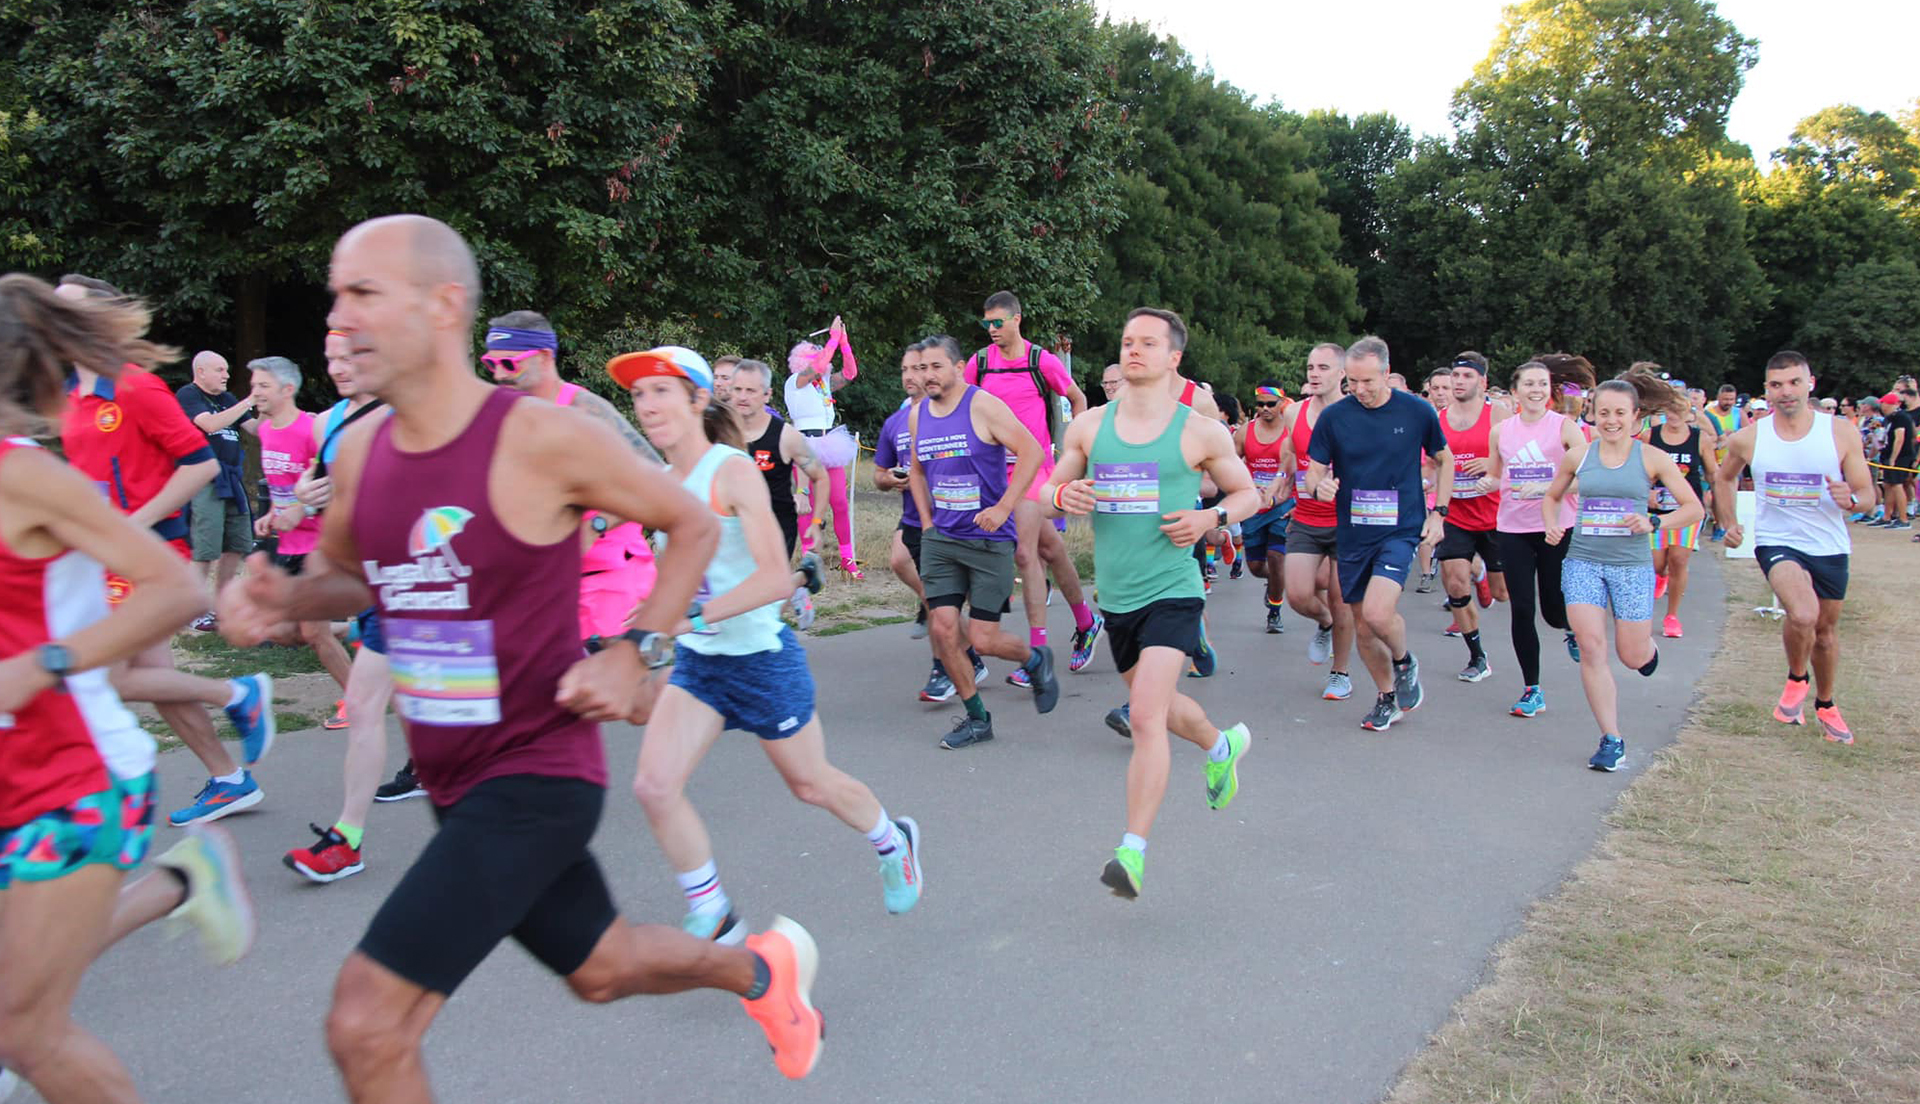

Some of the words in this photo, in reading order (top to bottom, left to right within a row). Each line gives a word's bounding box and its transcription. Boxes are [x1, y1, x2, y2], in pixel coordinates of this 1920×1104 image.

[1681, 453, 1691, 463] IS
[1109, 484, 1138, 497] 176
[1592, 513, 1618, 525] 214
[380, 582, 472, 612] General
